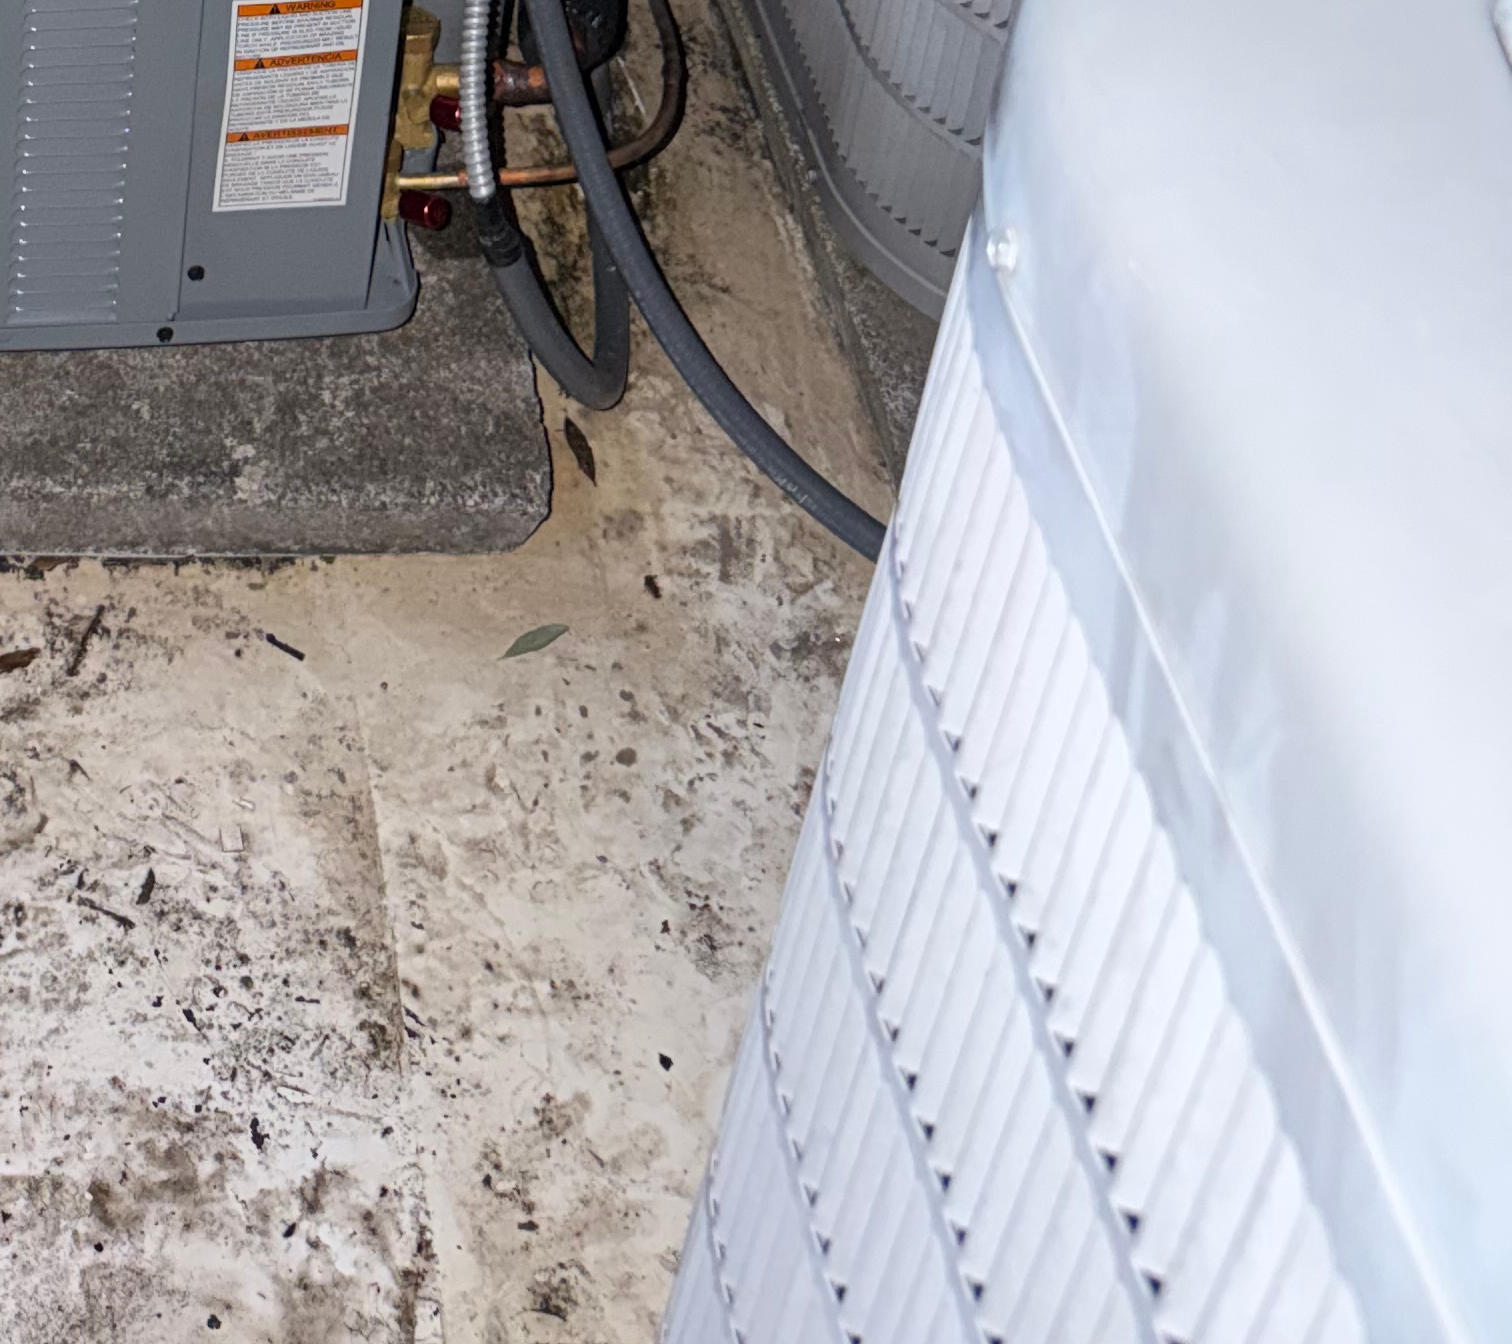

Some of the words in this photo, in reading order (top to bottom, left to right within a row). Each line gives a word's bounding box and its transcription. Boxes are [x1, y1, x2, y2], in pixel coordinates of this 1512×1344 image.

[286, 0, 336, 11] WARNING
[270, 53, 342, 67] ADVERTENCIA
[253, 126, 337, 139] AVERTISSEMENT
